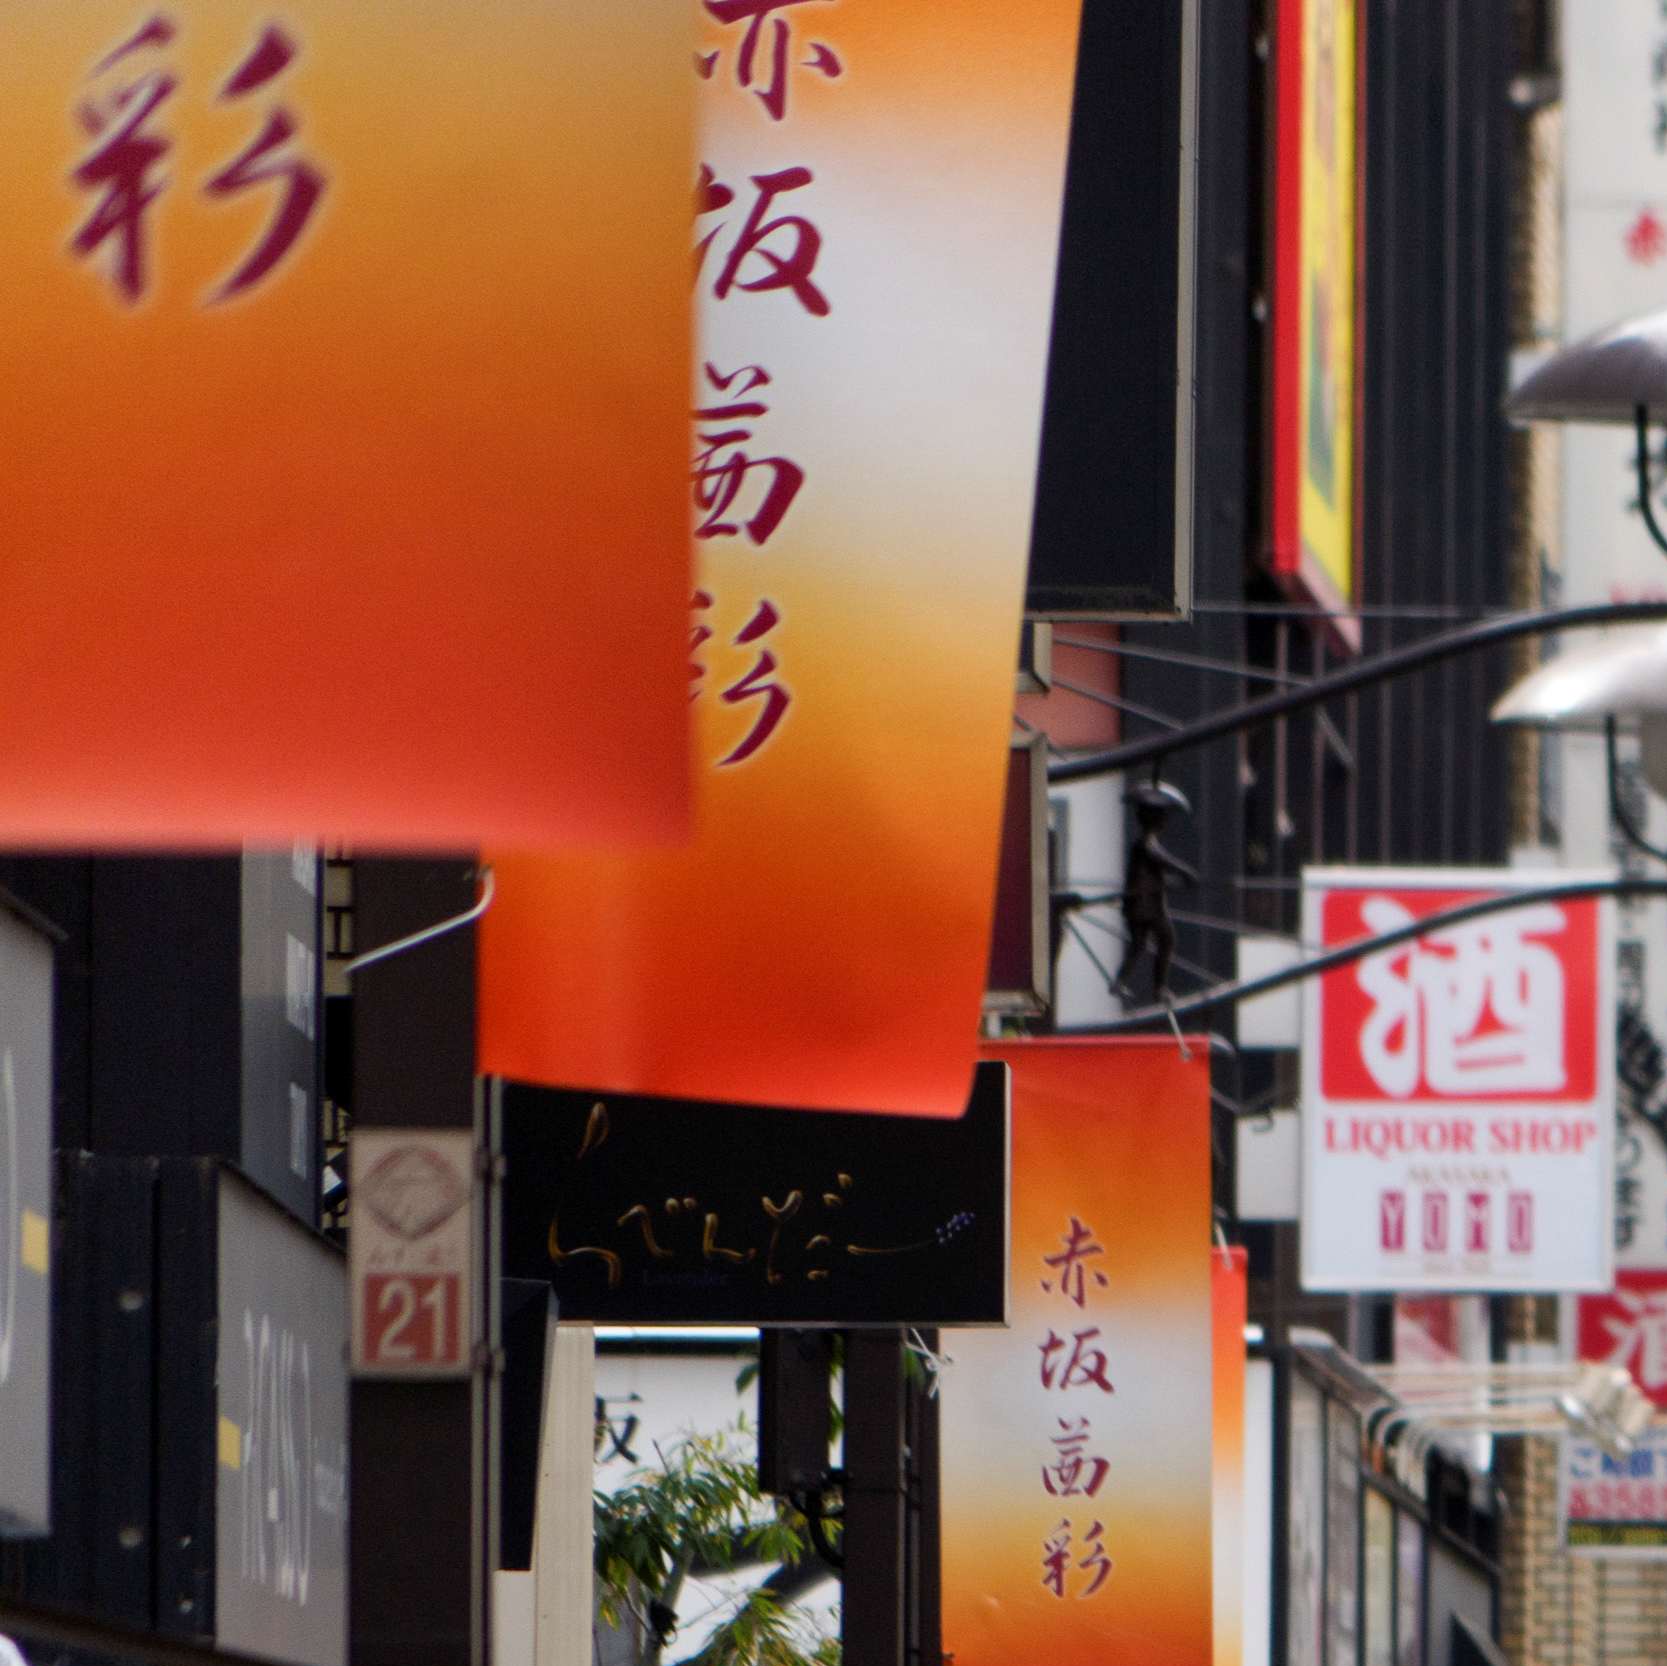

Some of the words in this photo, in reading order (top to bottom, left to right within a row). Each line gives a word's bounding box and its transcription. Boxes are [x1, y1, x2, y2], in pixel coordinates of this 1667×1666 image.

[1357, 896, 1568, 1097] 酒
[1324, 1120, 1477, 1158] LIQUOR
[1488, 1120, 1598, 1156] SHOP
[377, 1279, 448, 1360] 21
[1039, 1214, 1116, 1600] 赤坂茜彩
